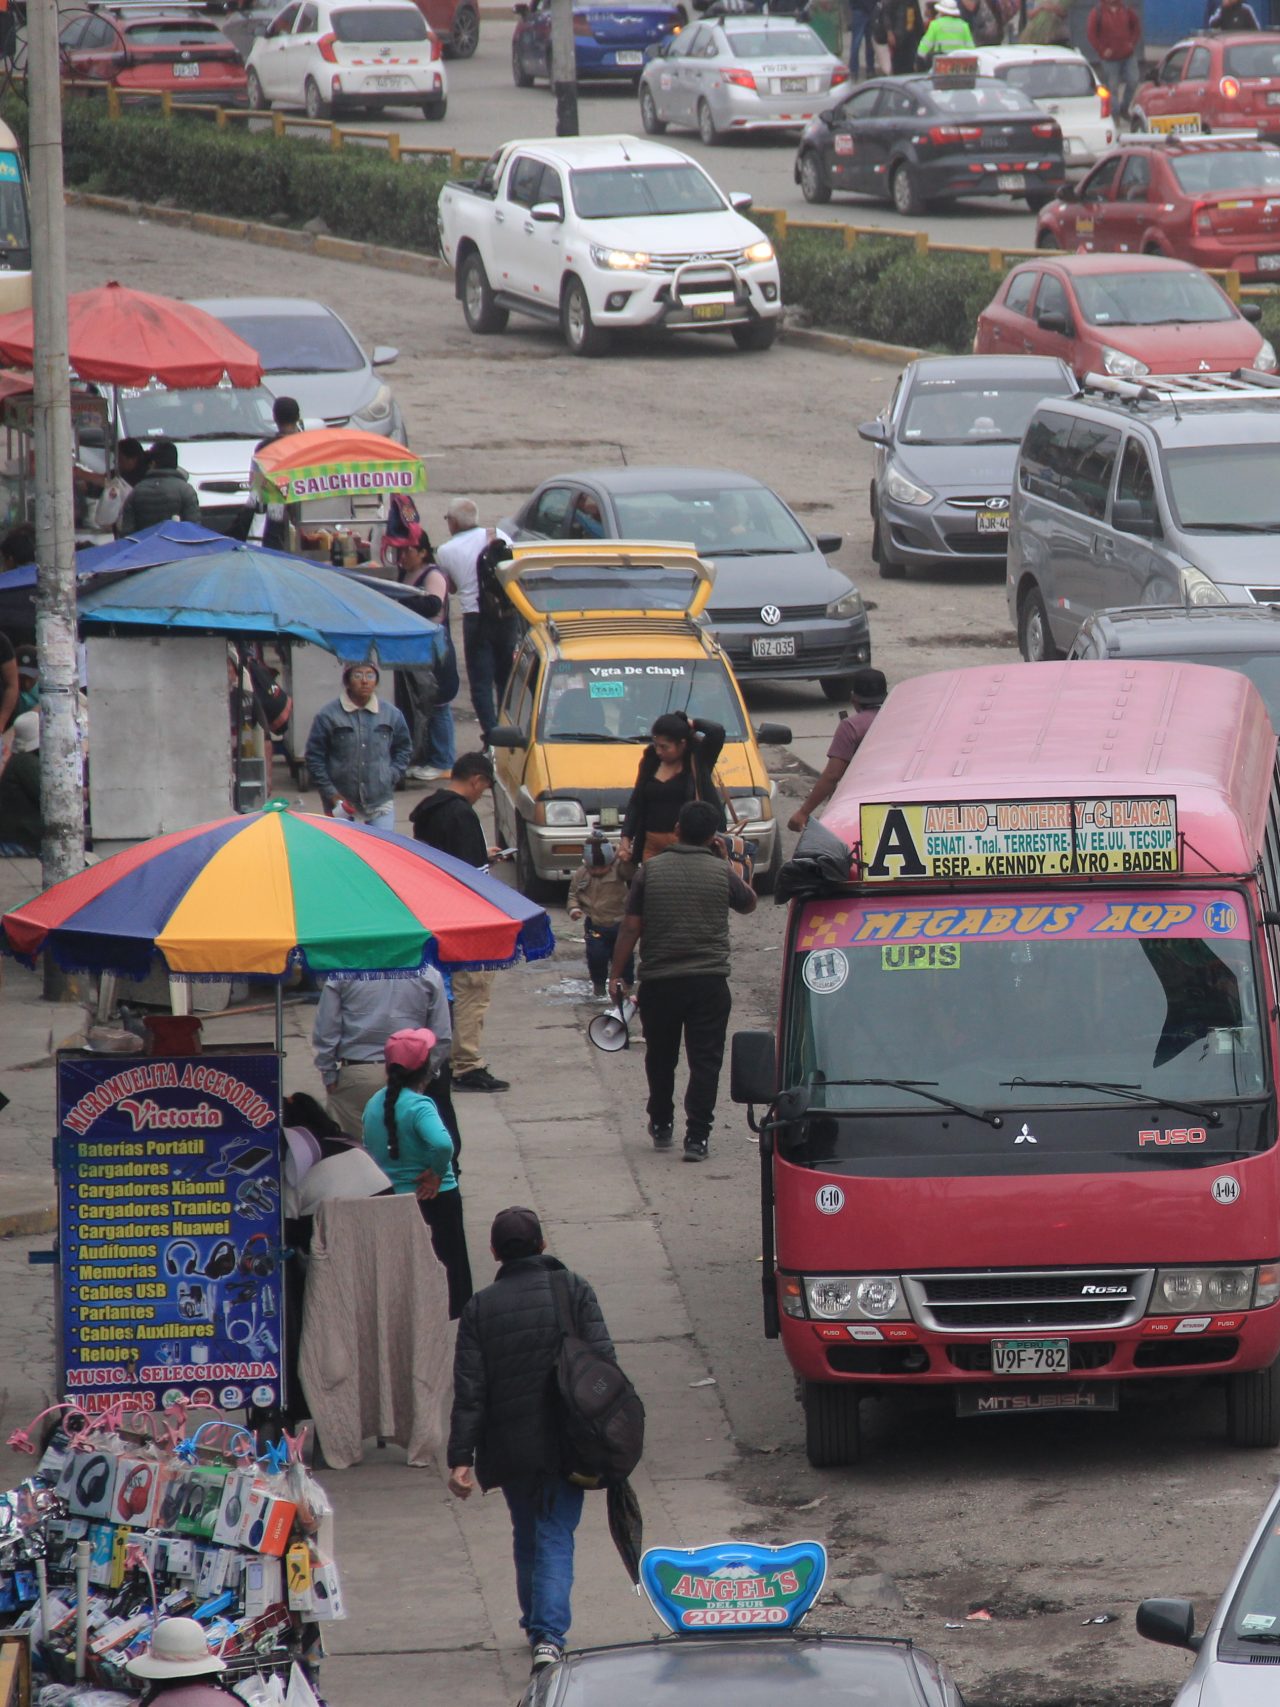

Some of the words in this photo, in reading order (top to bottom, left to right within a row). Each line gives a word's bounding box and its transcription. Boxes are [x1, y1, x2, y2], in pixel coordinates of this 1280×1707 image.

[294, 472, 413, 495] SALCHICONO
[753, 641, 794, 656] V8Z-035
[590, 667, 621, 677] Vgta
[624, 666, 642, 674] De
[646, 666, 685, 677] Chapi
[925, 805, 988, 833] AVELINO
[997, 801, 1086, 830] MONTERREY
[1094, 801, 1111, 827] C.
[1112, 800, 1172, 827] BLANCA
[868, 808, 926, 876] A
[927, 835, 965, 855] SENATI
[975, 835, 1001, 853] Tnal.
[1091, 831, 1126, 850] EE.UU.
[1130, 830, 1172, 849] TECSUP
[933, 857, 972, 877] ESEP.
[985, 854, 1047, 875] KENNDY
[1060, 853, 1109, 874] CAYRO
[1123, 851, 1172, 871] BADEN
[852, 905, 1083, 941] MEGABUS
[1091, 904, 1196, 932] AQP
[1206, 908, 1236, 929] C-10
[885, 945, 958, 967] UPIS
[63, 1062, 179, 1135] MICROMUELITA
[179, 1064, 275, 1128] ACCESORIOS
[117, 1098, 222, 1132] Victoria
[1139, 1128, 1207, 1145] FUSO
[78, 1141, 144, 1157] Baterías
[146, 1139, 204, 1155] Portátil
[78, 1163, 168, 1179] Cargadores
[78, 1183, 169, 1200] Cargadores
[172, 1180, 225, 1195] Xiaomi
[821, 1190, 840, 1207] C-10
[1215, 1182, 1237, 1198] A-04
[78, 1203, 169, 1219] Cargadores
[172, 1201, 231, 1215] Tranico
[78, 1223, 169, 1240] Cargadores
[172, 1220, 230, 1236] Huawei
[78, 1243, 158, 1259] Audífonos
[79, 1264, 158, 1280] Memorias
[79, 1285, 133, 1301] Cables
[136, 1283, 167, 1298] USB
[79, 1305, 154, 1321] Parlantes
[79, 1325, 134, 1342] Cables
[136, 1323, 215, 1339] Auxiliares
[823, 1329, 840, 1337] FUSO
[889, 1329, 907, 1337] FUSO
[1217, 1320, 1235, 1328] FUSO
[80, 1346, 139, 1362] Relojes
[1017, 1341, 1044, 1349] PERU
[995, 1347, 1067, 1370] V9F-782
[67, 1367, 138, 1386] MUSICA
[140, 1362, 277, 1383] SELECCIONADA
[978, 1394, 1096, 1411] MITSUBISHI
[706, 1601, 734, 1609] DEL
[736, 1600, 764, 1608] SUR
[689, 1609, 783, 1625] 202020
